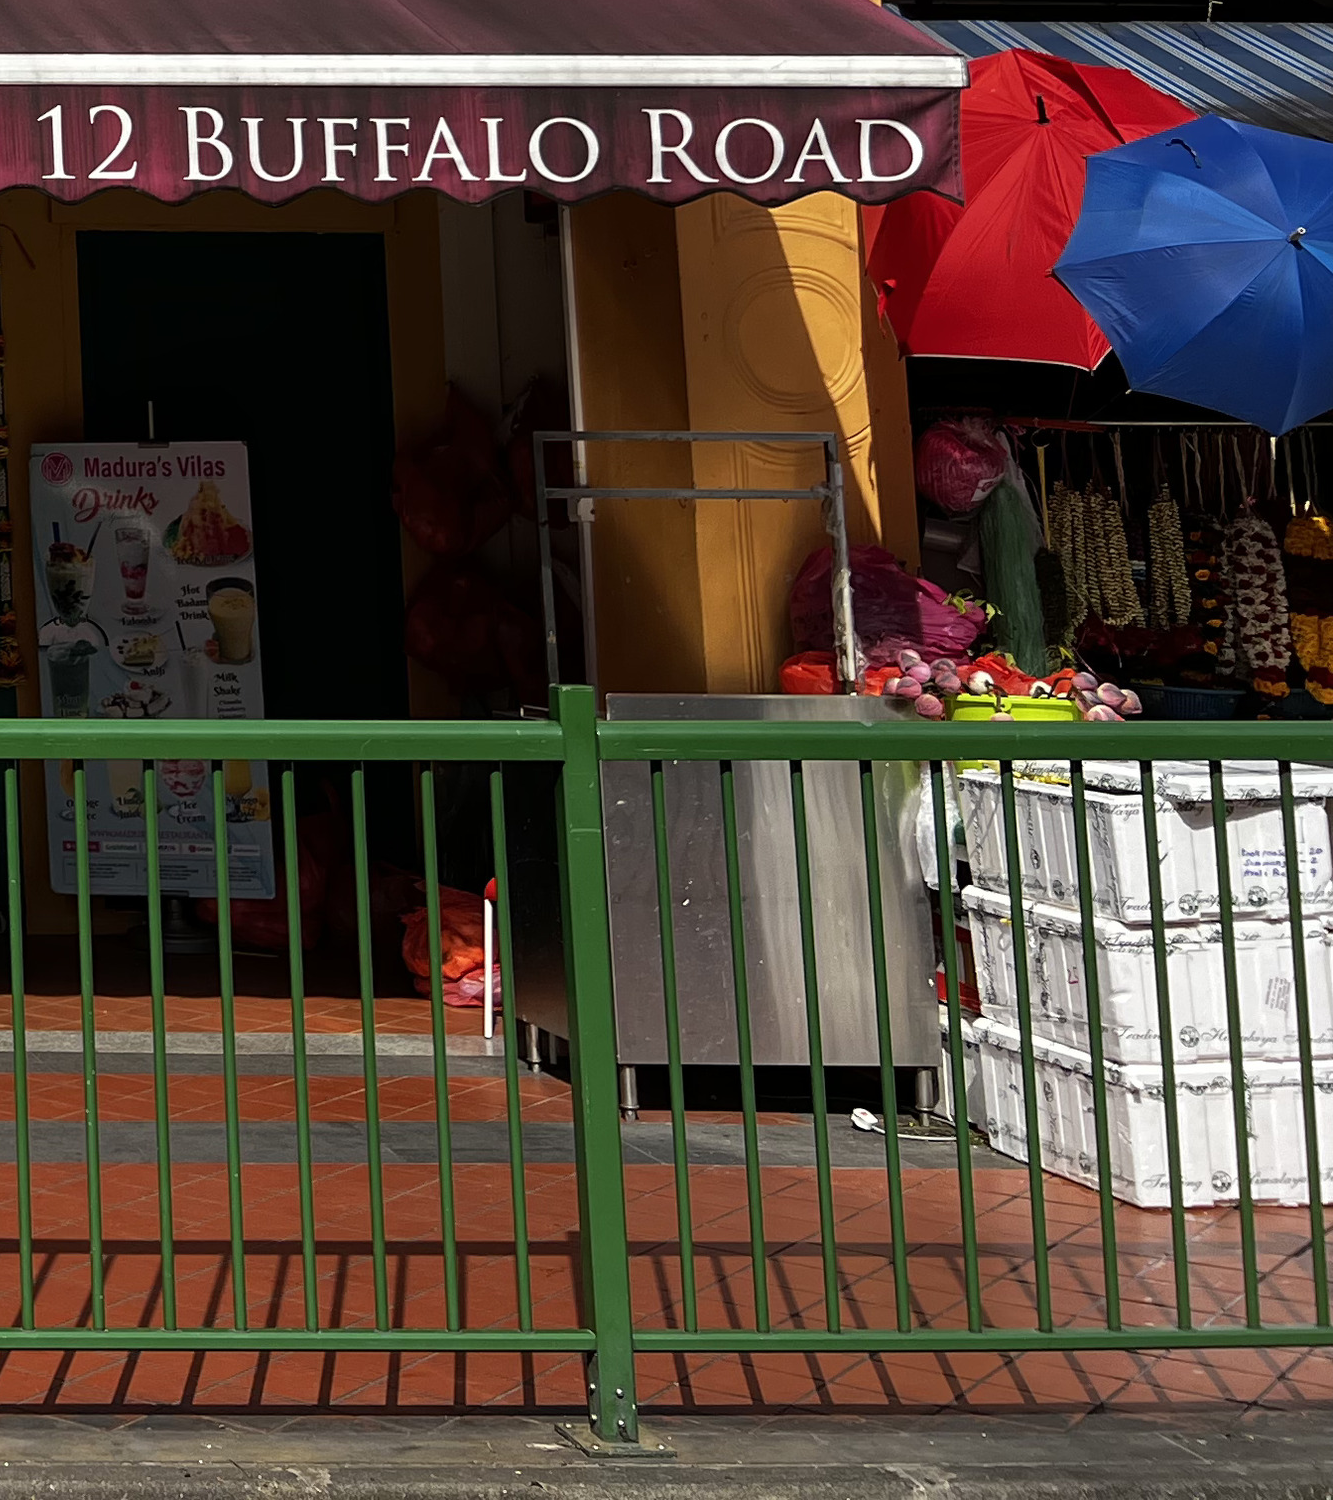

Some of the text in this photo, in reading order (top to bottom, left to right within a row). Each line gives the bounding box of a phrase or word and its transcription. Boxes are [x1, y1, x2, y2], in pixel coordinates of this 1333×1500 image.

[36, 103, 924, 185] 12 BUFFALO ROAD
[84, 456, 226, 478] Madura's Vilas
[72, 486, 159, 523] Drinks
[179, 610, 210, 620] Drink
